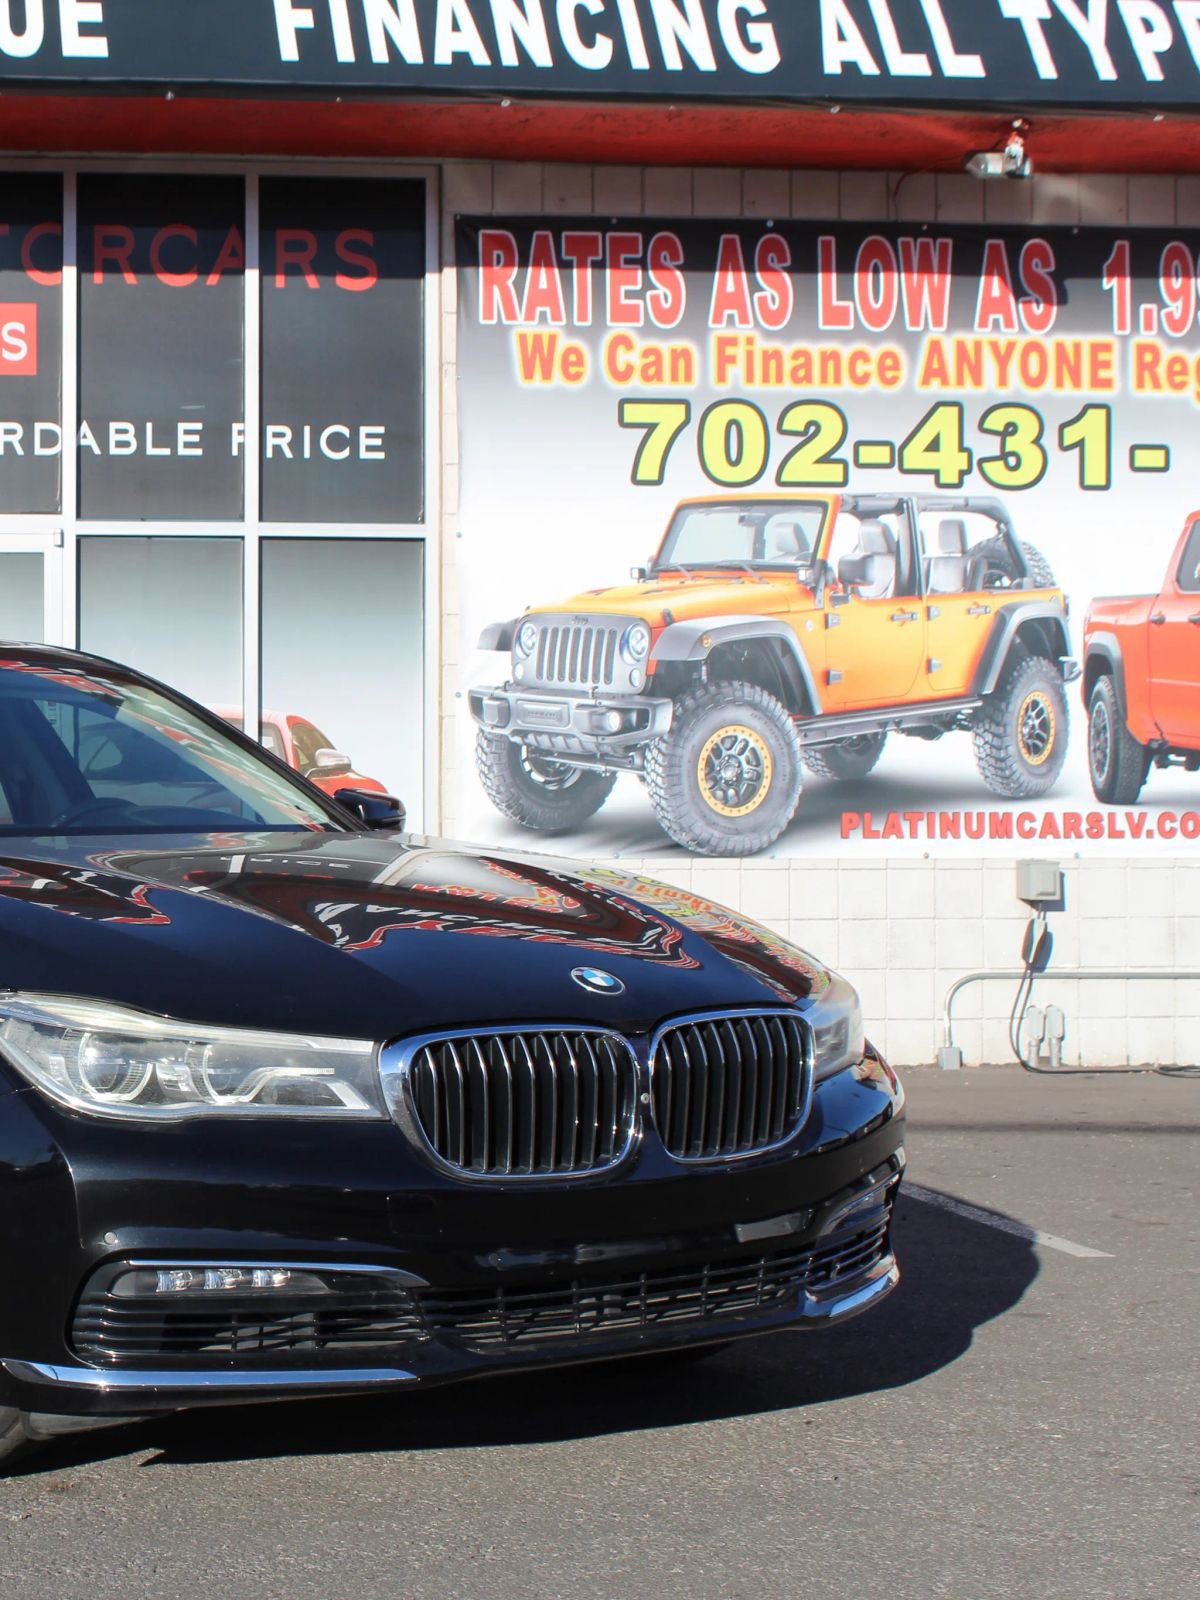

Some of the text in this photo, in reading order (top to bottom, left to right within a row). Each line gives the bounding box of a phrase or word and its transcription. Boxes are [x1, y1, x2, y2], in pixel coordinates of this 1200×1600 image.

[275, 0, 782, 74] FINANCING
[822, 0, 986, 78] ALL
[478, 229, 1200, 338] RATES AS LOW AS 1.9
[517, 332, 1200, 400] We Can Finance ANYONE Re
[617, 398, 1170, 492] 702-431-
